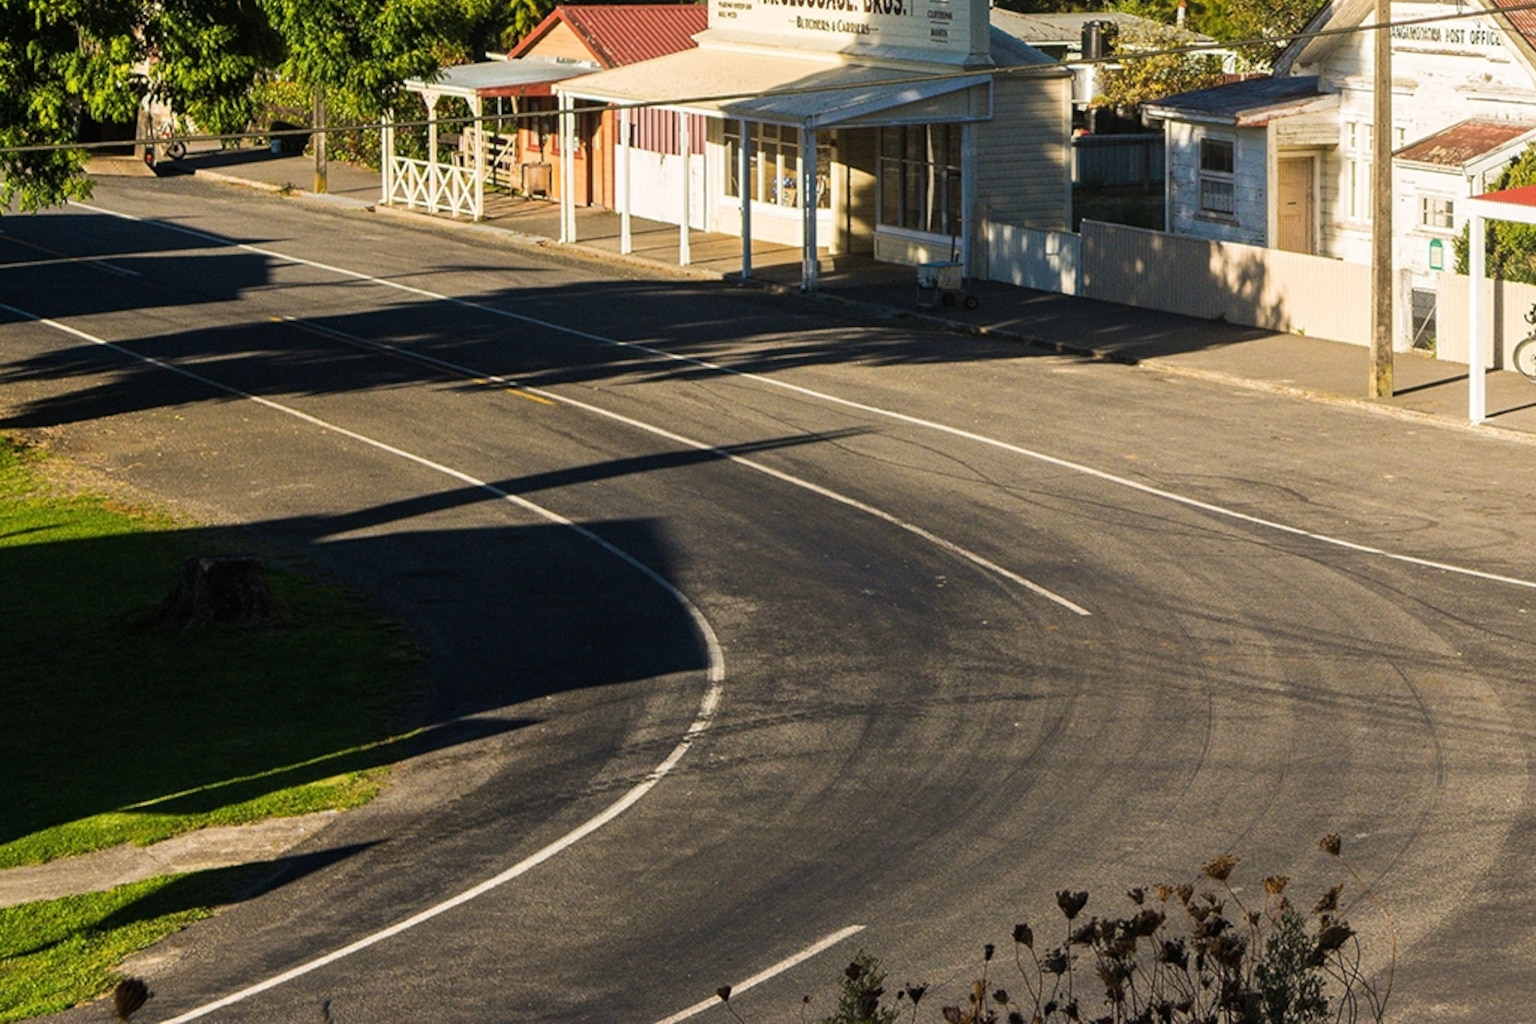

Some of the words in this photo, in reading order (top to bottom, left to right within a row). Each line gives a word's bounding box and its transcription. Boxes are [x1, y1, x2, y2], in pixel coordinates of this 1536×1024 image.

[796, 16, 830, 32] BUTCHERS
[837, 19, 870, 35] CARRIERS
[1445, 28, 1465, 44] POST
